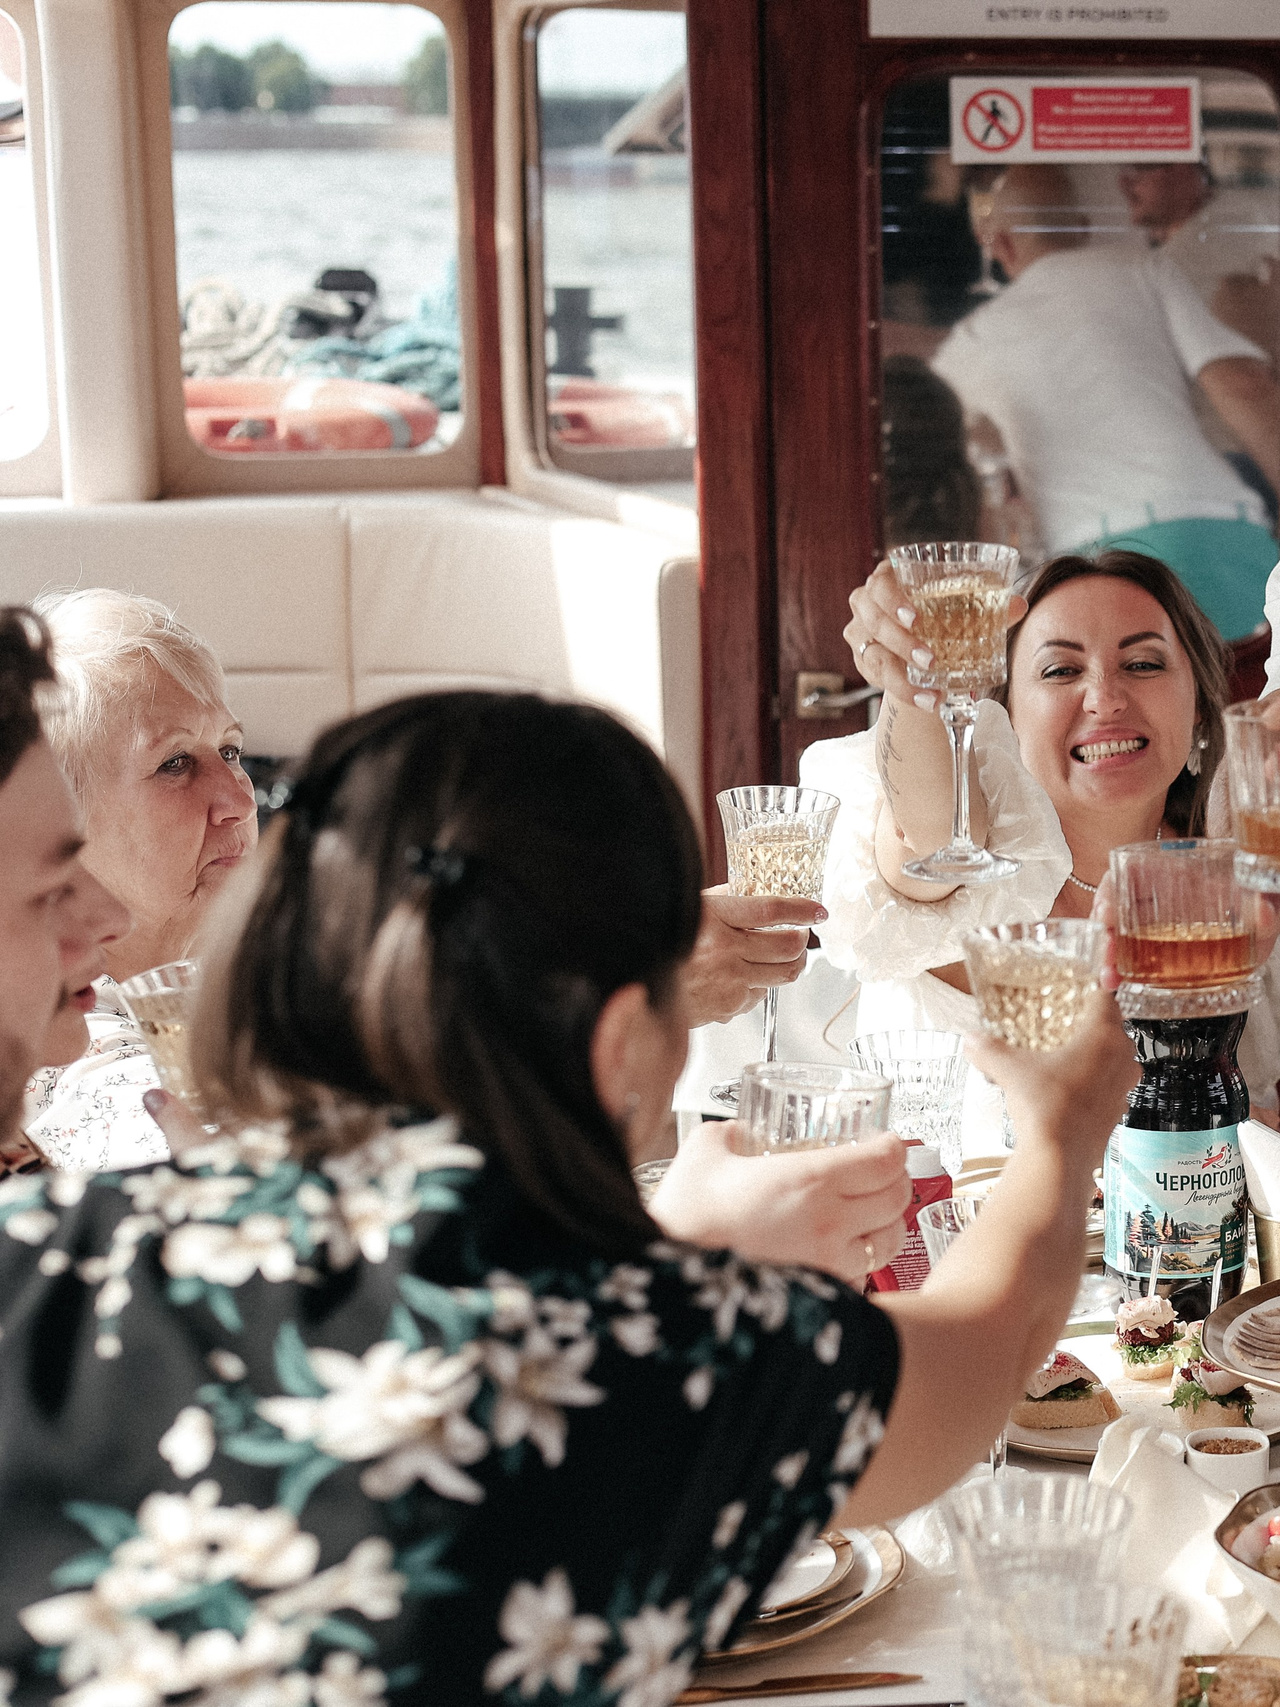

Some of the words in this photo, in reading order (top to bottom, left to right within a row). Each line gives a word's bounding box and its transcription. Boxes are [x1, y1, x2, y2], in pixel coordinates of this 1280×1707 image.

[986, 7, 1042, 22] ENTRY
[1046, 7, 1063, 22] IS
[1067, 7, 1170, 23] PROHIBITED
